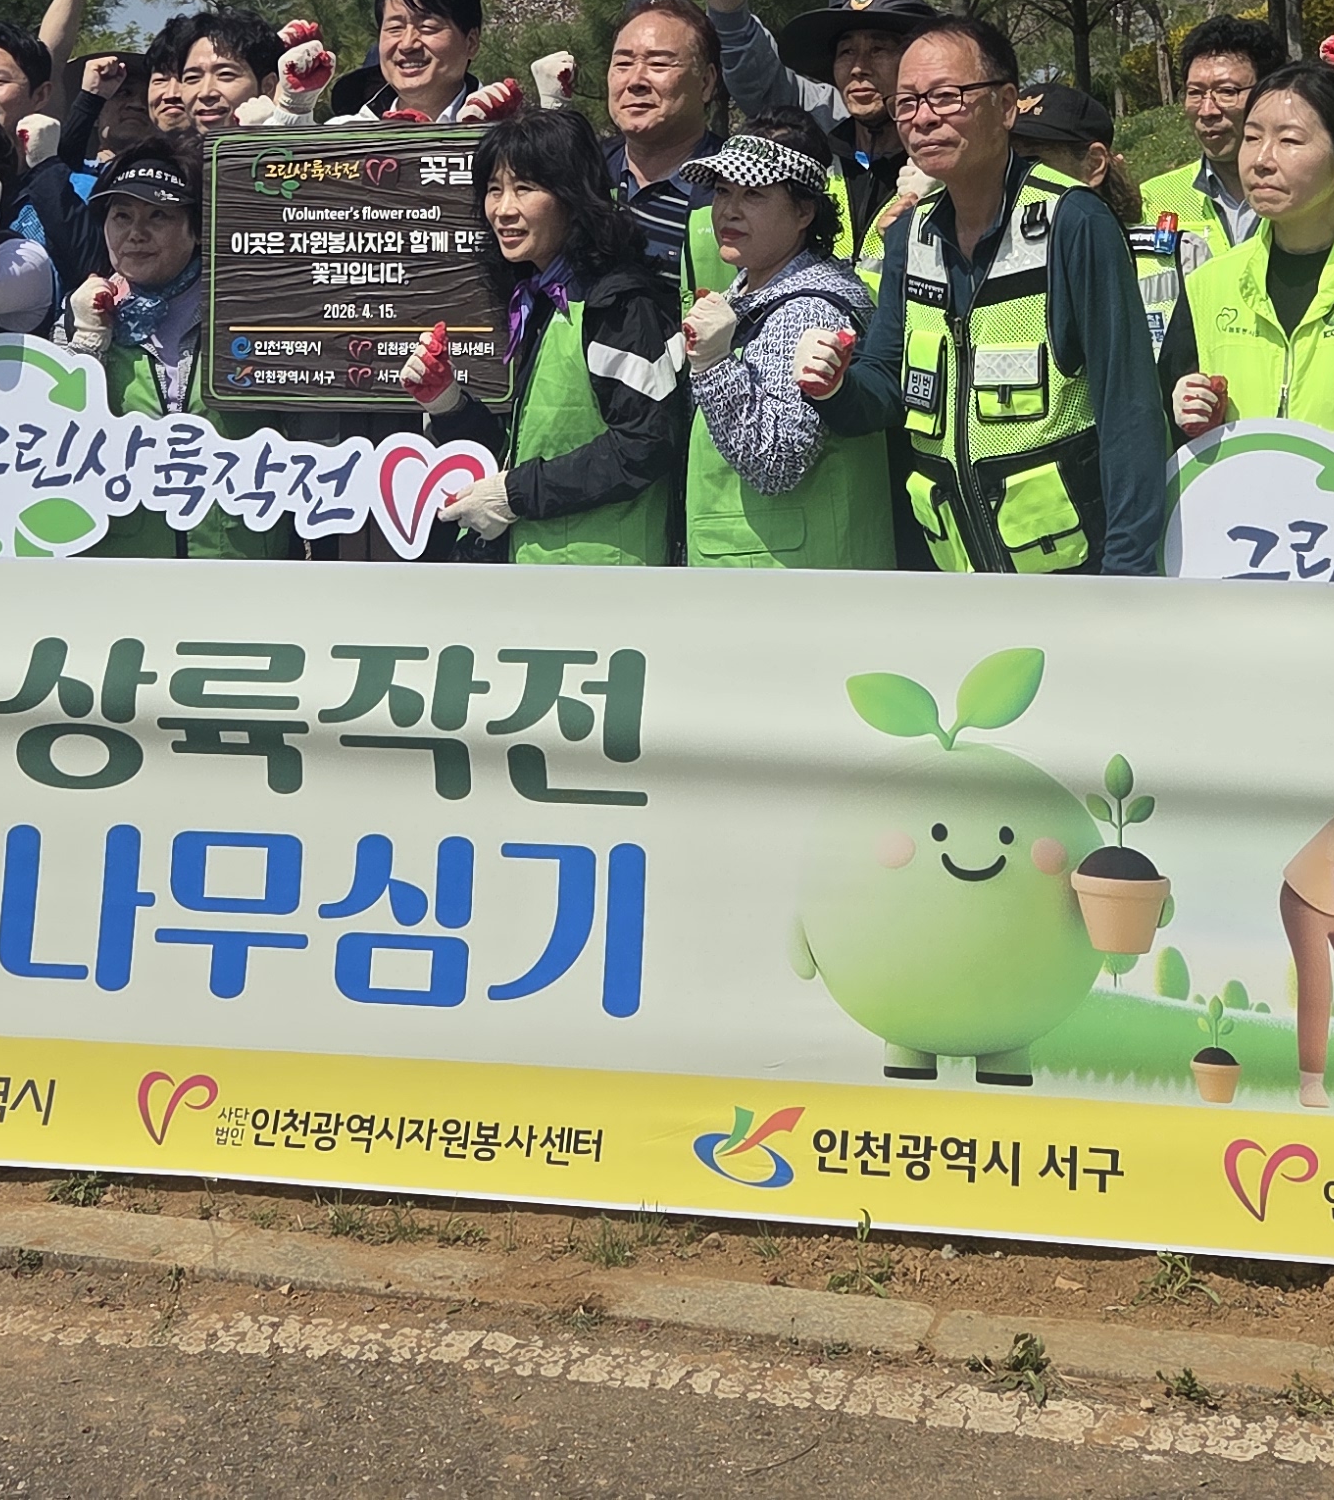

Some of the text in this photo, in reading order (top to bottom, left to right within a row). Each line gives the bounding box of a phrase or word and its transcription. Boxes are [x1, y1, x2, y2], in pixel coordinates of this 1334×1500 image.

[264, 155, 474, 186] 그린상륙작전 꽃길
[282, 206, 442, 222] (Volunteer's flower road)
[230, 231, 286, 255] 이곳은
[289, 231, 404, 255] 자원봉사자와
[409, 231, 449, 254] 함께
[311, 262, 410, 286] 꽃길입니다.
[323, 303, 397, 319] 2026. 4. 15.
[253, 340, 322, 356] 인천광역시
[377, 341, 495, 356] 인천광역봉사센터
[253, 369, 336, 385] 인천광역시 서구
[911, 373, 932, 398] 방범
[218, 1105, 249, 1127] 사단
[214, 1126, 245, 1148] 법인
[250, 1107, 604, 1167] 인천광역시자원봉사센터
[812, 1127, 1125, 1194] 인천광역시 서구
